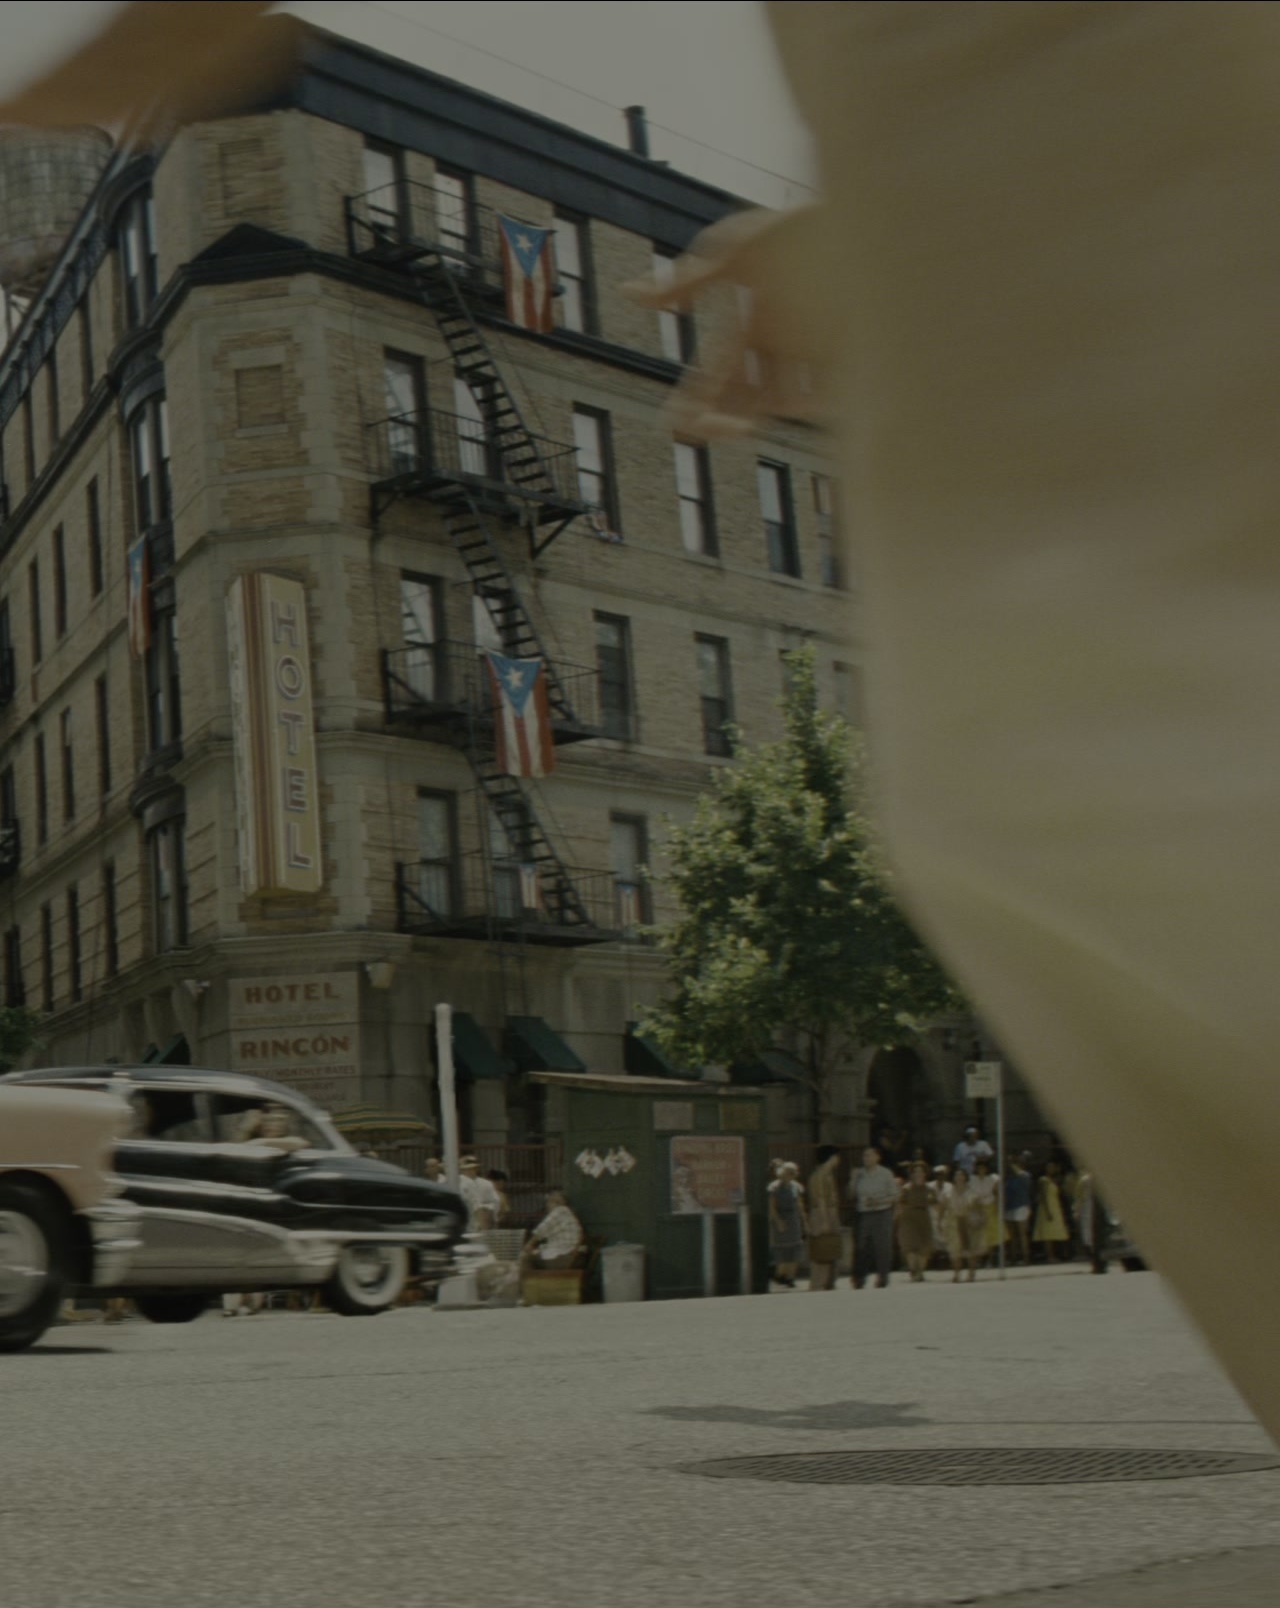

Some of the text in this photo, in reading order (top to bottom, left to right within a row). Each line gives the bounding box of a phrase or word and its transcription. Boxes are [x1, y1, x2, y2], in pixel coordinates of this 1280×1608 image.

[271, 603, 312, 869] HOTEL
[246, 983, 339, 1003] HOTEL
[239, 1034, 351, 1060] RINCÓN
